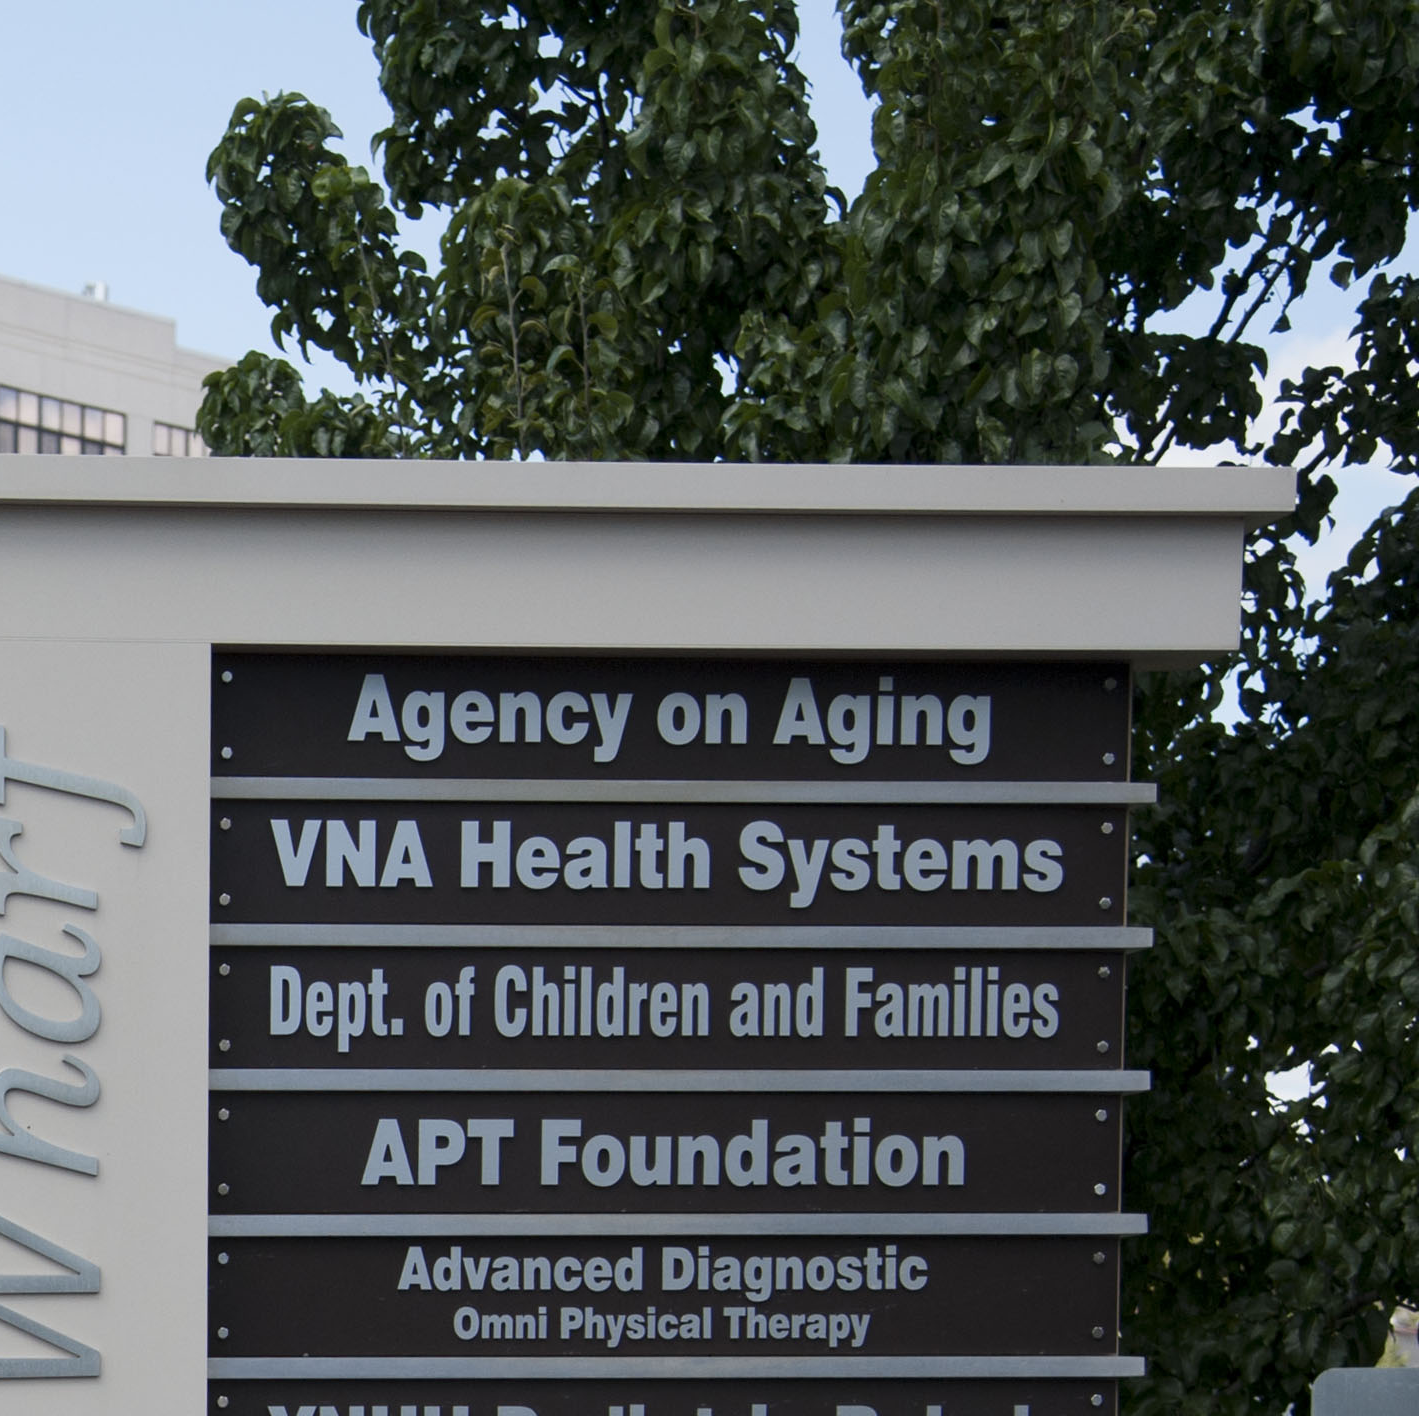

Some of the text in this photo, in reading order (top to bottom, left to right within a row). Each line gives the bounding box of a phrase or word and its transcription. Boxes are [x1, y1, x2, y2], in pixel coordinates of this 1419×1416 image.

[348, 674, 991, 765] Agency on Aging
[270, 818, 1064, 908] VNA Health Systems
[269, 964, 1059, 1053] Dept. of Children and Families
[360, 1117, 965, 1187] APT Foundation
[397, 1244, 928, 1302] Advanced Diagnostic
[453, 1306, 871, 1348] Omni Physical Therapy
